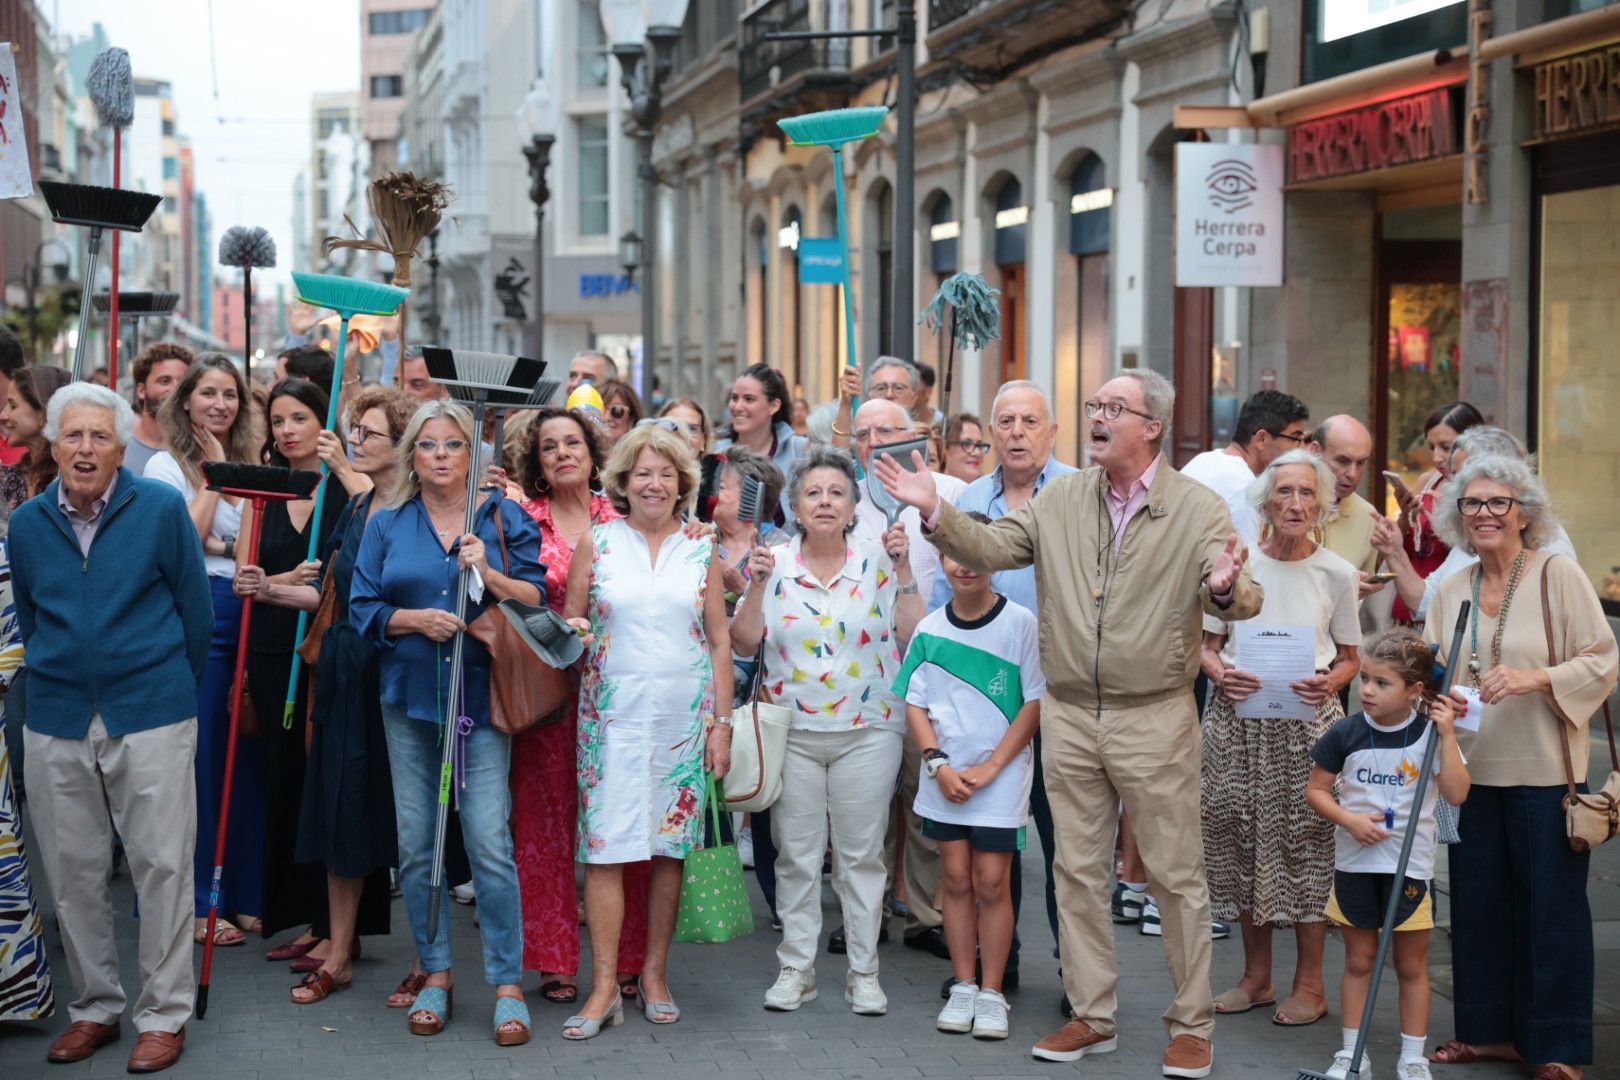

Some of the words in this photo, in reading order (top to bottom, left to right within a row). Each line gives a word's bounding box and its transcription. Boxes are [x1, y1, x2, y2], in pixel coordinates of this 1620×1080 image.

[1289, 110, 1378, 183] HERRERA
[1377, 88, 1450, 168] CERPA
[1195, 219, 1265, 237] Herrera
[1203, 239, 1257, 258] Cerpa
[1357, 767, 1404, 787] Claret
